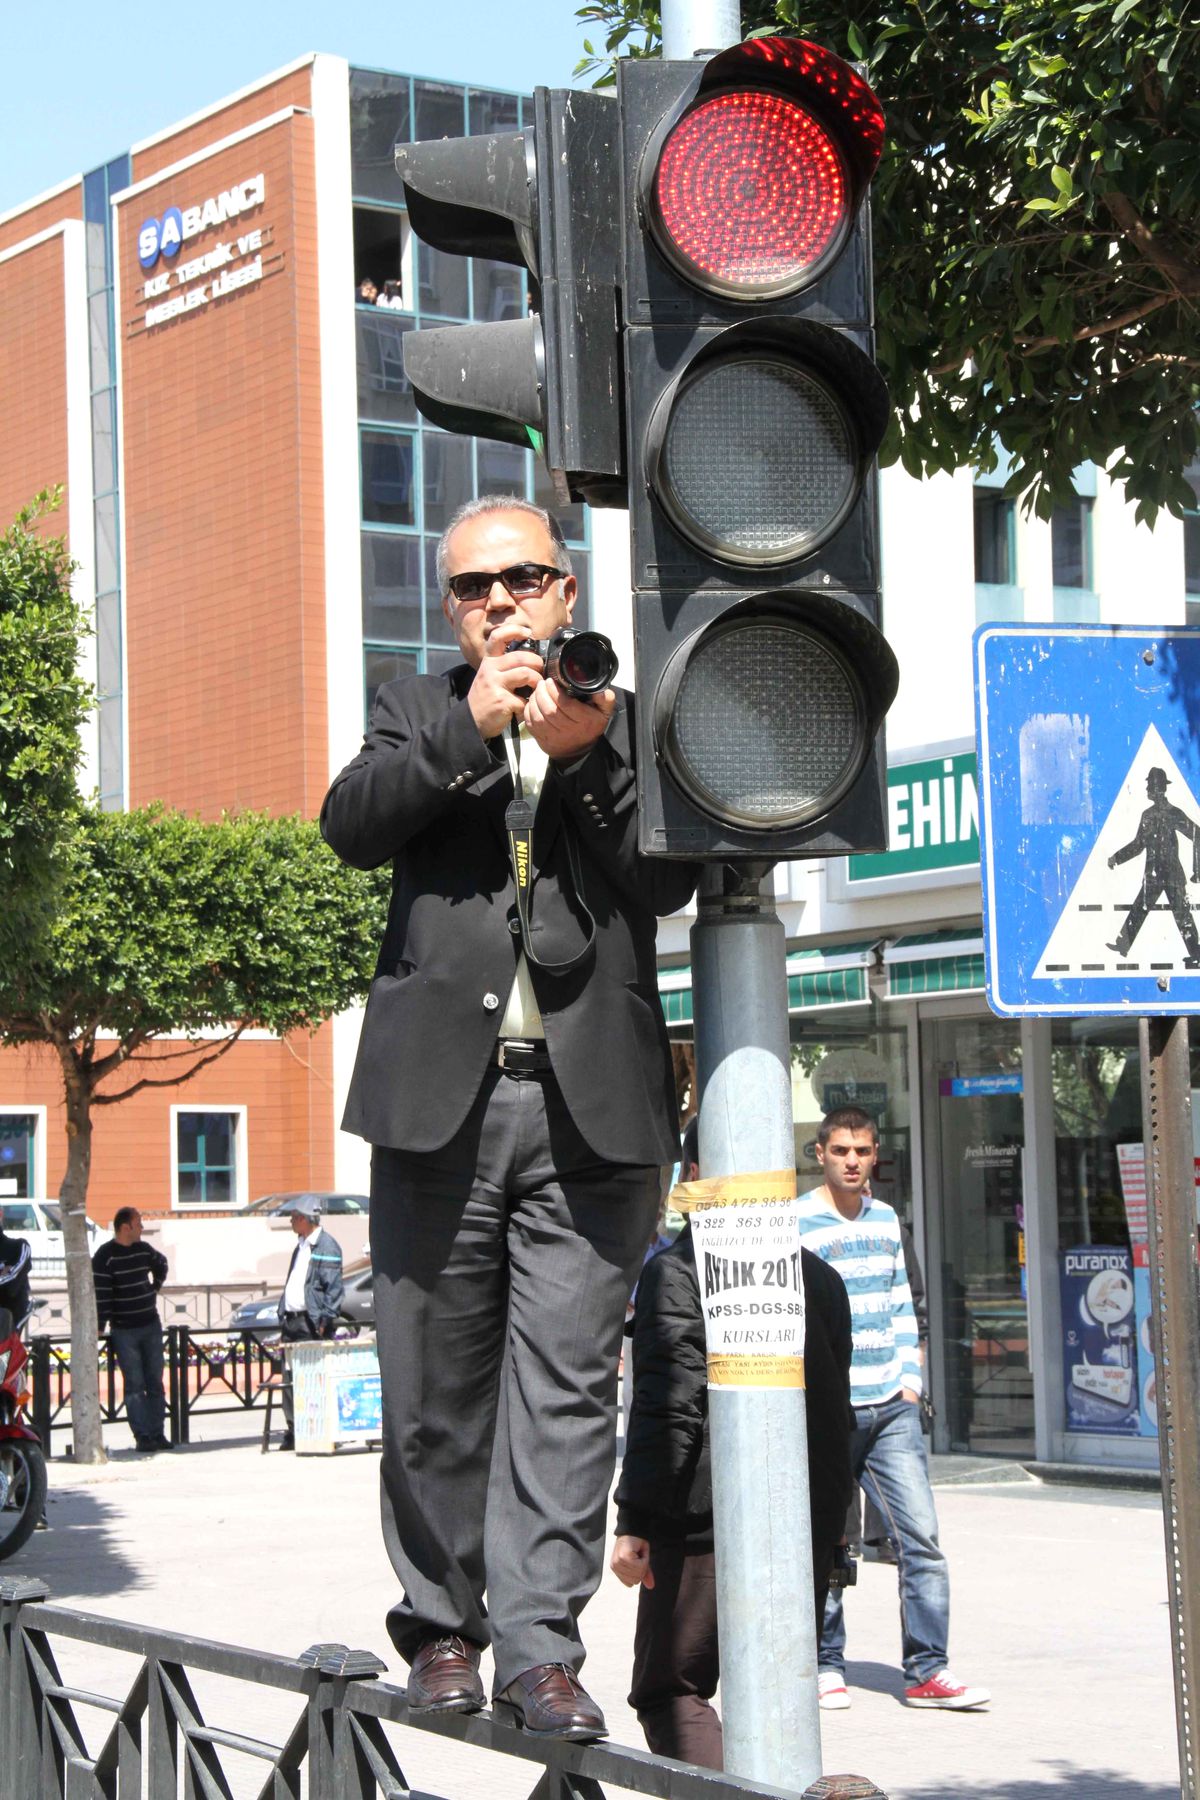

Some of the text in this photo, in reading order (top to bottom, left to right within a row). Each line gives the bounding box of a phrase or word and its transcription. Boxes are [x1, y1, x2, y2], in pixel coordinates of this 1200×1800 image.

[139, 173, 265, 259] SABANCI
[144, 229, 262, 299] KIZ TEKNİK VE
[516, 840, 528, 887] Nikon
[731, 1198, 757, 1209] 472
[761, 1196, 777, 1209] 38
[704, 1218, 726, 1229] 322
[736, 1217, 762, 1229] 363
[770, 1216, 784, 1228] 00
[705, 1251, 757, 1299] AYLIK
[762, 1258, 788, 1289] 20
[1065, 1255, 1128, 1275] puranox
[723, 1329, 796, 1344] KURSLARI
